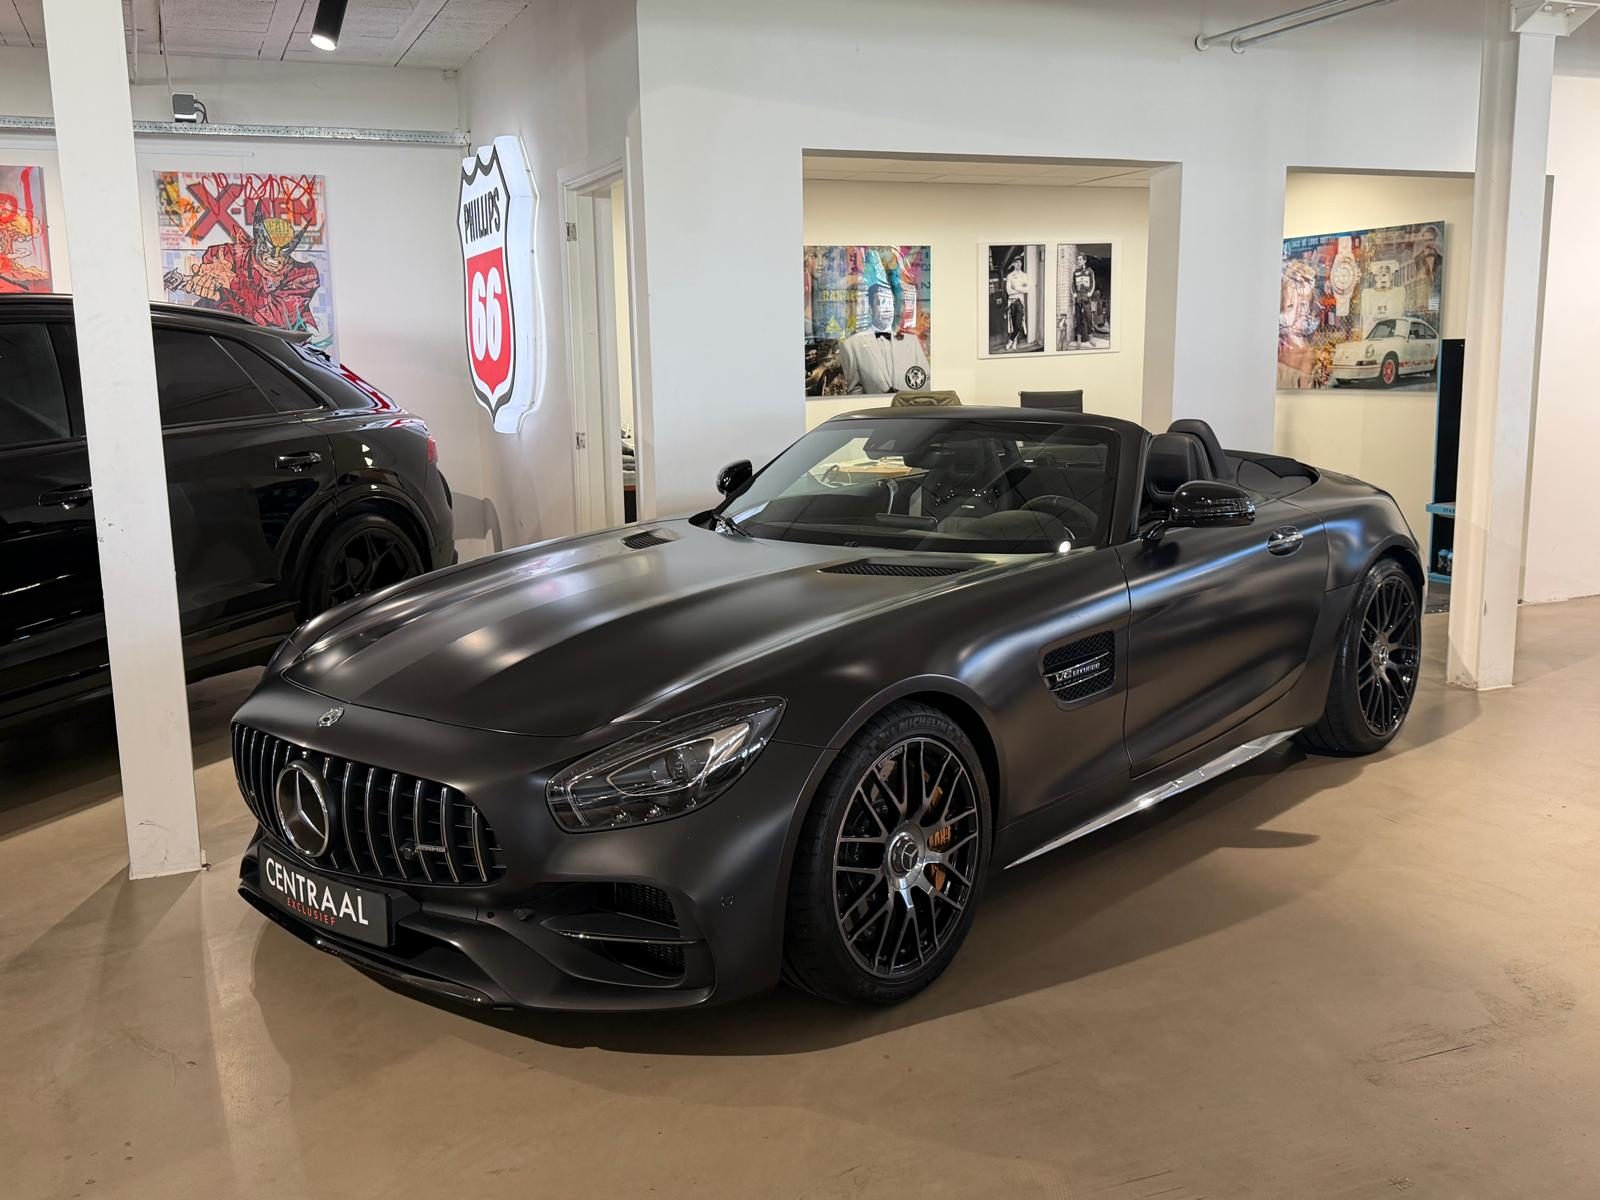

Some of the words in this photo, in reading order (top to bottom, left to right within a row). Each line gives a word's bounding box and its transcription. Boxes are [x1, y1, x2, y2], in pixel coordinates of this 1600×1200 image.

[186, 182, 317, 242] X-MEN
[463, 186, 500, 245] PHILLIPS
[471, 266, 502, 361] 66
[899, 715, 948, 732] MICHELIN
[265, 857, 369, 926] CENTRAAL
[287, 897, 336, 926] EXCLUSIEF
